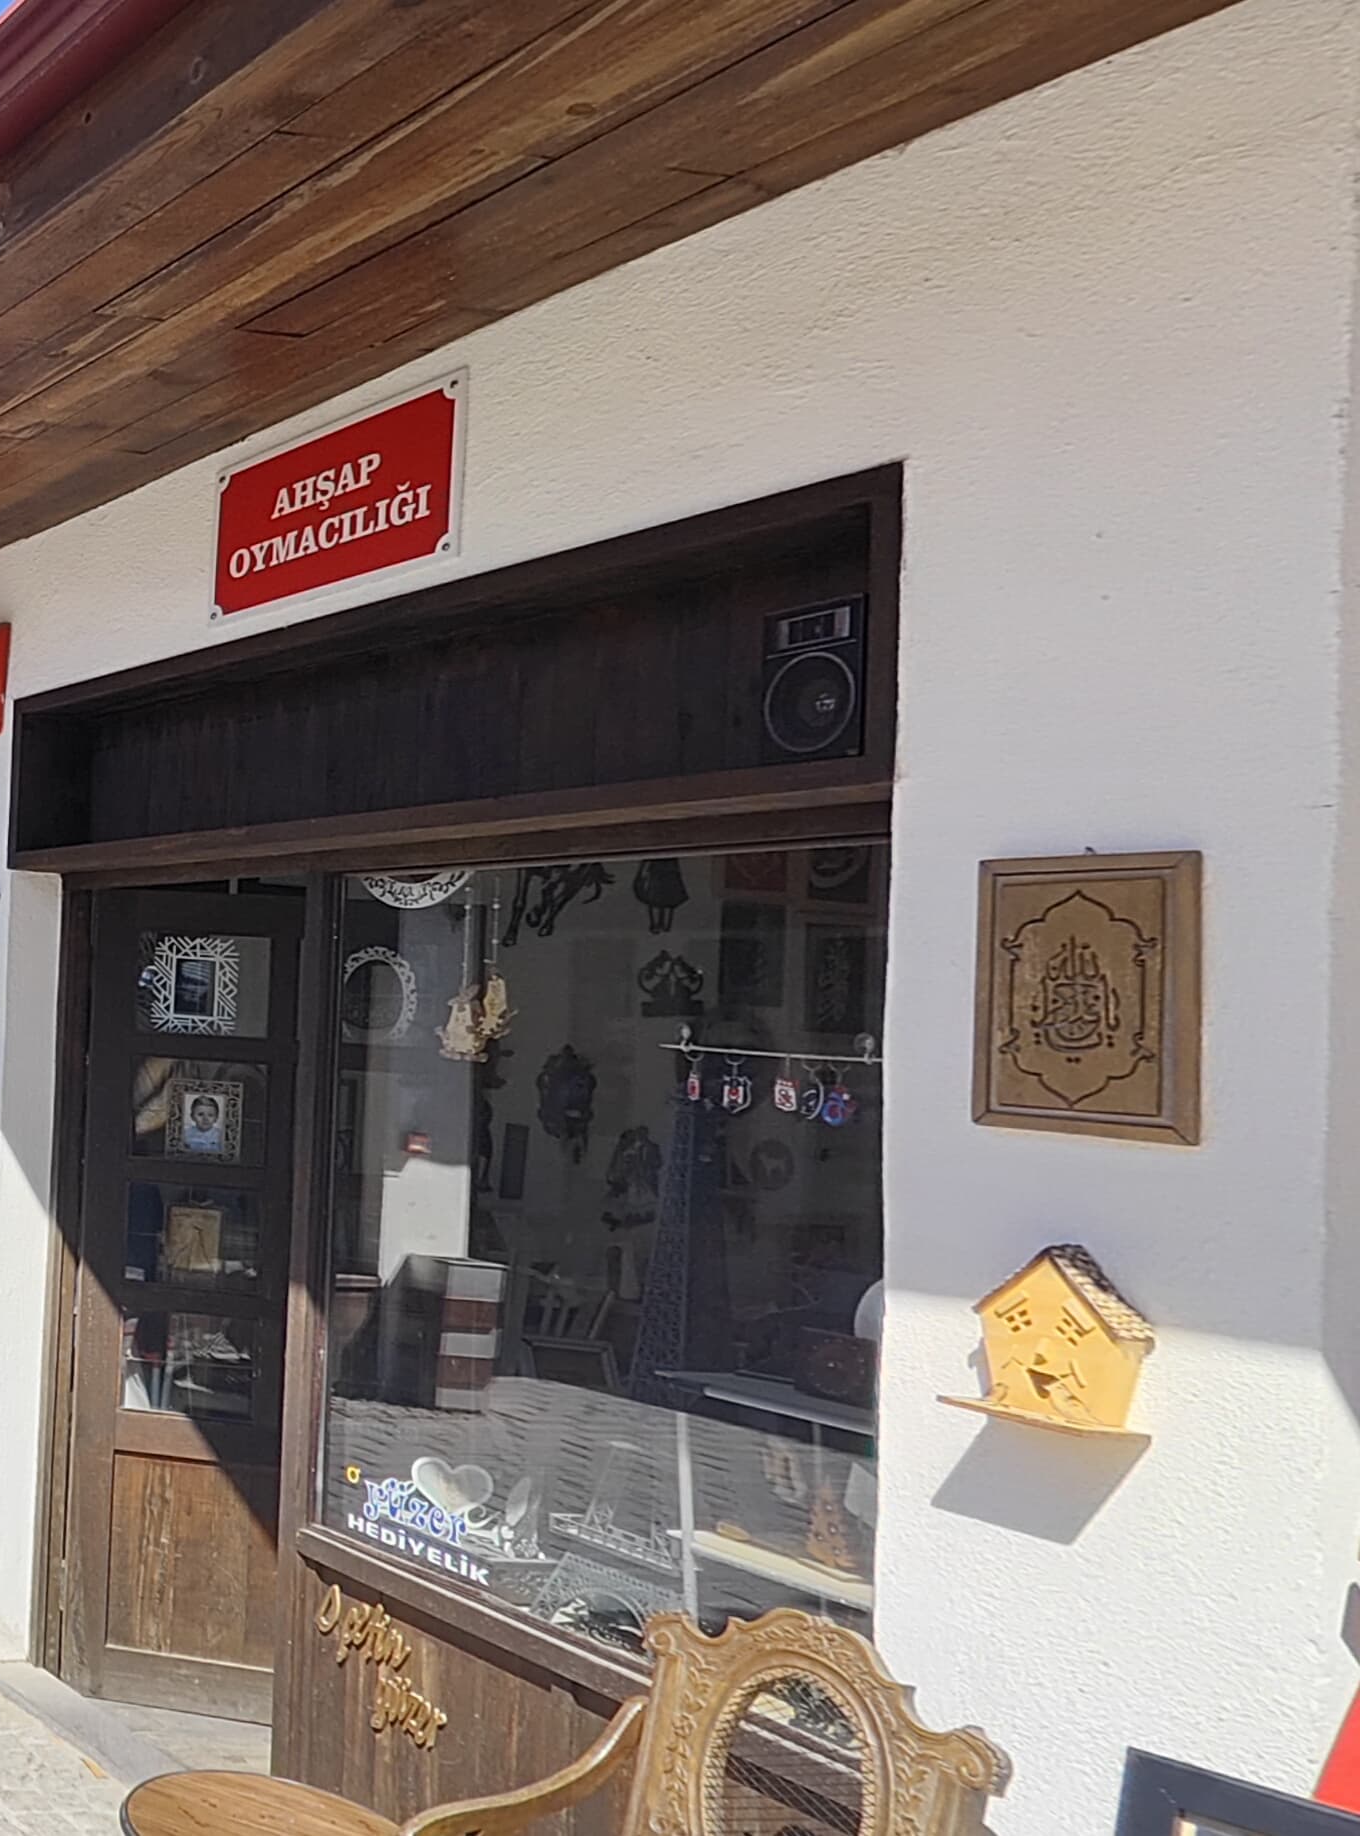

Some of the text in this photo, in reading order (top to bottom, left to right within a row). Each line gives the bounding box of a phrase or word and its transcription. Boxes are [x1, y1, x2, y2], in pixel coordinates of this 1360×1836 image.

[270, 453, 381, 520] AHŞAP
[229, 481, 432, 578] OYMACILIĞI
[347, 1513, 491, 1586] HEDİYELİK
